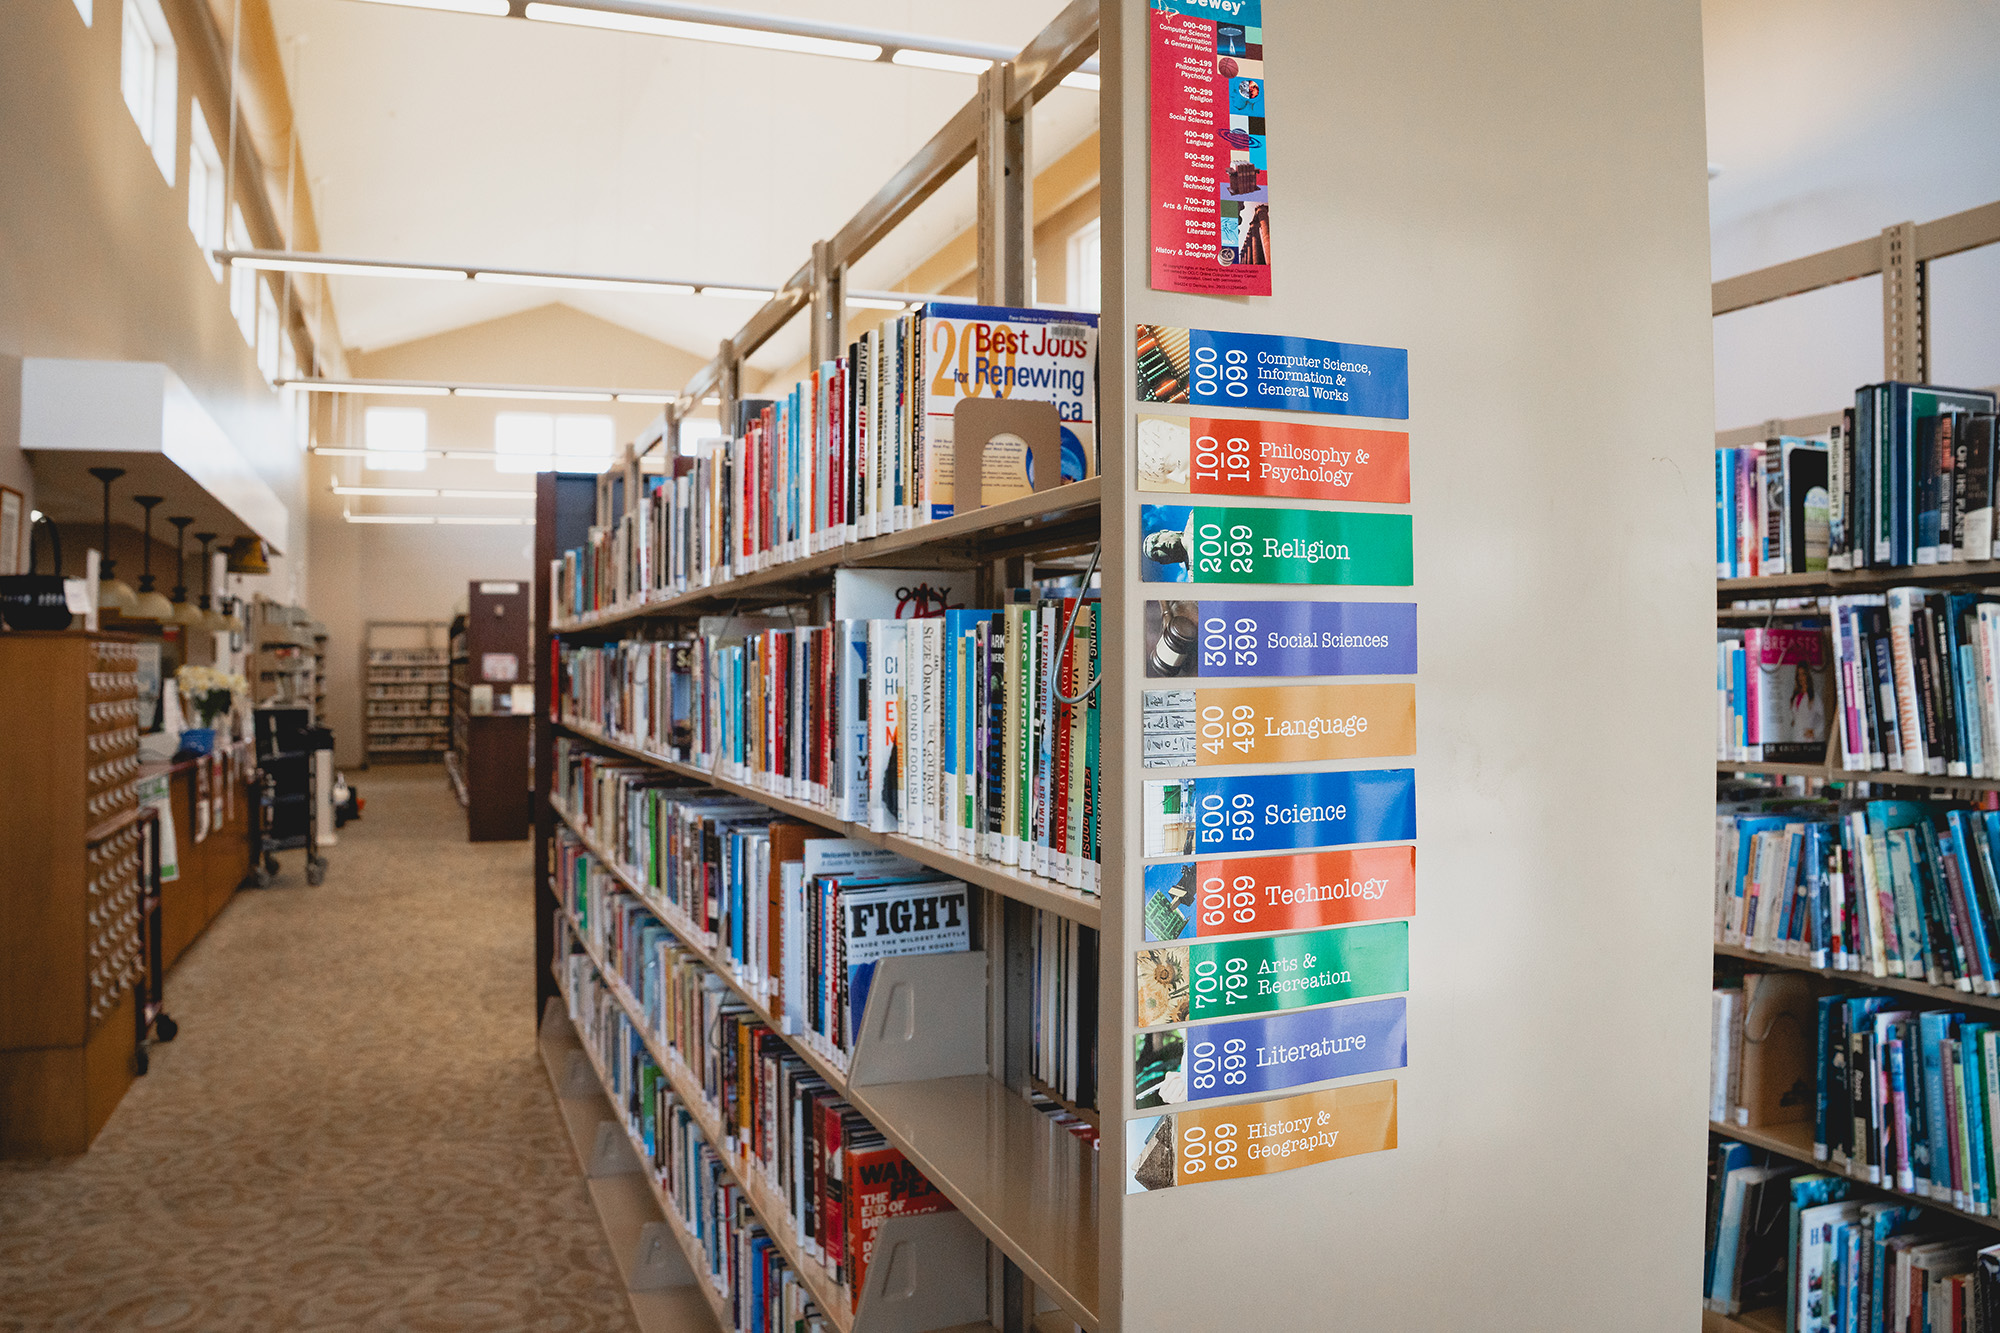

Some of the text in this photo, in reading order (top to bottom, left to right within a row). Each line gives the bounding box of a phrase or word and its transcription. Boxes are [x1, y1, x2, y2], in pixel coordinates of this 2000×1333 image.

[1160, 24, 1212, 39] Computer Science,
[1171, 39, 1193, 50] General
[1194, 44, 1212, 53] Works
[1179, 35, 1212, 45] Information
[1175, 63, 1206, 76] Philosophy
[1181, 70, 1213, 83] Psychology
[1190, 94, 1213, 104] Religion
[1169, 113, 1213, 126] Social Sciences
[1186, 137, 1214, 148] Language
[1191, 161, 1214, 169] Science
[1183, 181, 1215, 193] Technology
[1183, 204, 1215, 214] Recreation
[1187, 228, 1216, 237] Literature
[1155, 246, 1177, 255] History
[1185, 250, 1216, 259] Geography
[976, 323, 1029, 354] Best
[1033, 327, 1087, 358] Jobs
[953, 357, 1084, 396] for Renewing
[1195, 347, 1217, 396] 000
[1225, 350, 1248, 398] 099
[1257, 352, 1372, 376] Computer Science,
[1257, 367, 1346, 386] Information &
[1257, 383, 1349, 402] General Works
[1196, 436, 1218, 481] 100
[1227, 437, 1250, 482] 199
[1259, 442, 1370, 465] Philosophy &
[1259, 463, 1354, 487] Psychology
[1200, 524, 1221, 573] 200
[1230, 525, 1253, 573] 299
[1262, 538, 1350, 563] Religion
[1041, 624, 1049, 677] FREEZING
[1090, 612, 1098, 658] YOUNG
[1204, 618, 1227, 666] 300
[1235, 618, 1257, 666] 399
[1267, 632, 1389, 649] Social Sciences
[923, 626, 934, 714] SUZE ORMAN
[1202, 706, 1224, 755] 400
[1232, 705, 1255, 754] 499
[1264, 716, 1368, 740] Language
[910, 694, 918, 806] POUND FOOLISH
[927, 740, 935, 808] COURAGE
[1083, 767, 1092, 816] KEVIN
[1038, 785, 1046, 838] BROWDER
[1202, 795, 1224, 843] 500
[1232, 794, 1255, 841] 599
[1265, 804, 1346, 825] Science
[1058, 807, 1066, 852] LEWIS
[1082, 816, 1091, 860] ROOSE
[1203, 877, 1225, 925] 600
[1233, 876, 1256, 923] 699
[1265, 878, 1389, 906] Technology
[850, 893, 965, 938] FIGHT
[864, 950, 880, 958] FOR
[901, 945, 926, 953] WHITE
[937, 930, 967, 939] BATTLE
[1257, 953, 1317, 975] Arts &
[1195, 961, 1217, 1009] 700
[1225, 958, 1248, 1005] 799
[1257, 969, 1351, 995] Recreation
[1193, 1042, 1215, 1089] 800
[1224, 1039, 1246, 1085] 899
[1256, 1033, 1367, 1067] Literature
[1247, 1111, 1331, 1140] History &
[1184, 1127, 1206, 1174] 900
[1215, 1123, 1237, 1170] 999
[1247, 1129, 1339, 1160] Geography
[860, 1191, 889, 1206] THE
[861, 1199, 907, 1218] END OF
